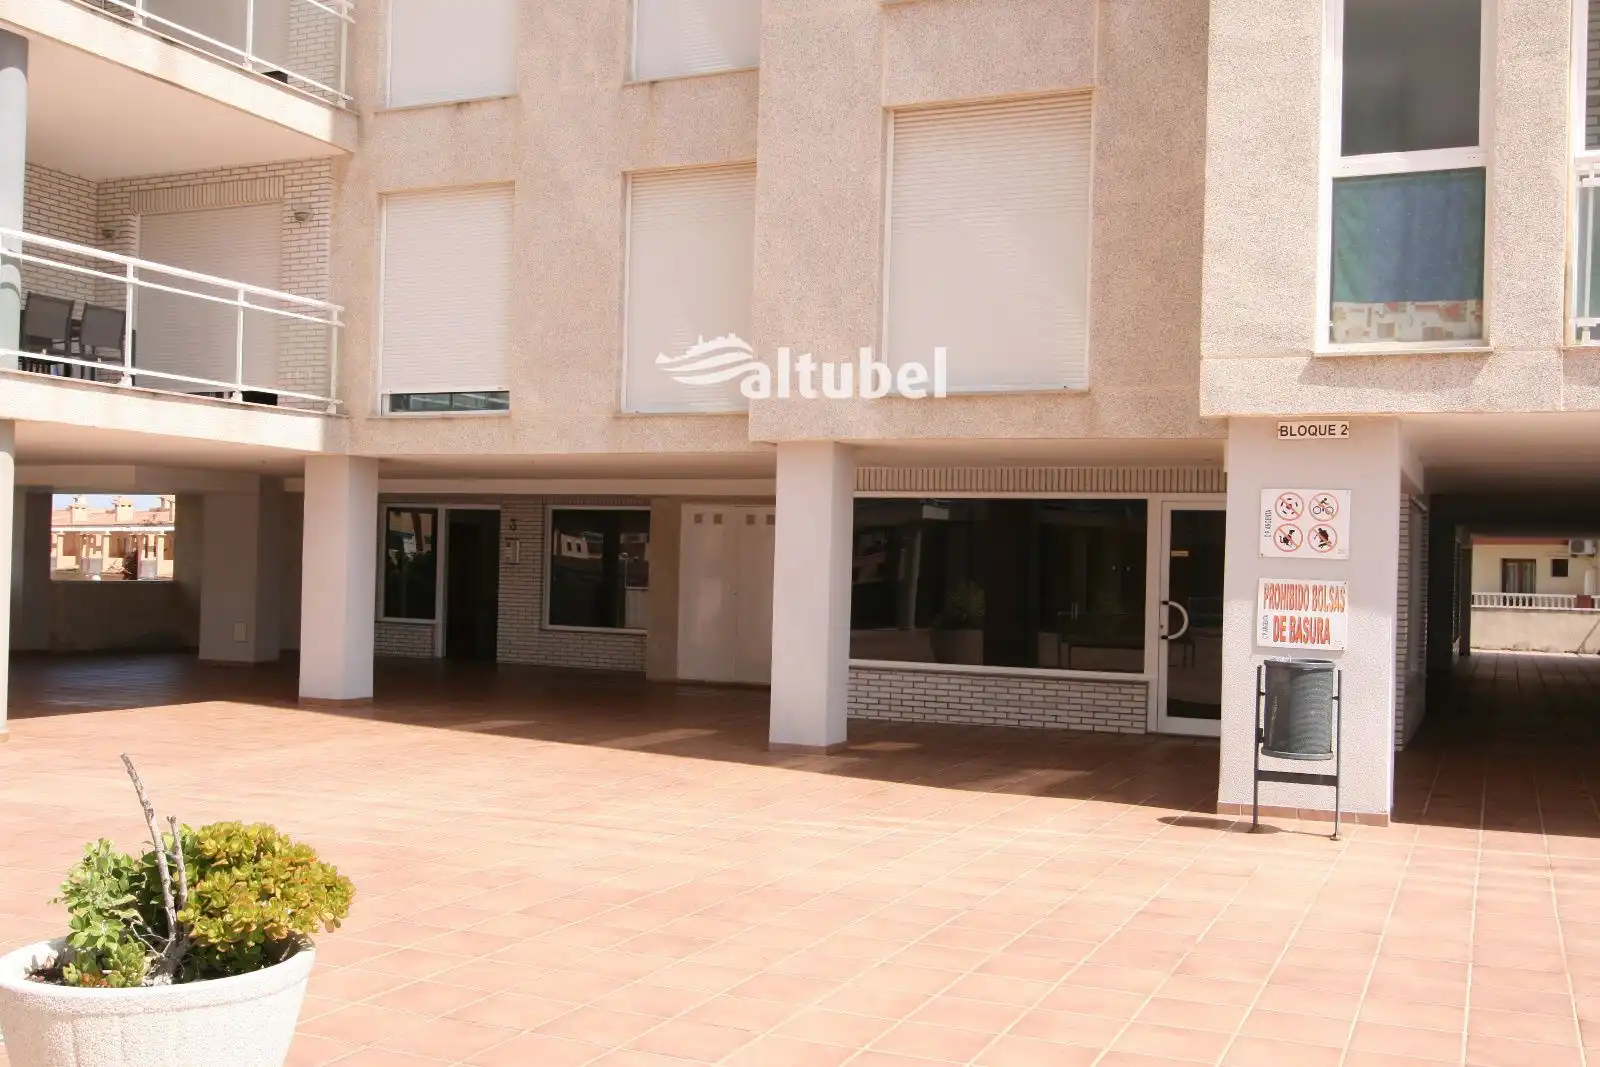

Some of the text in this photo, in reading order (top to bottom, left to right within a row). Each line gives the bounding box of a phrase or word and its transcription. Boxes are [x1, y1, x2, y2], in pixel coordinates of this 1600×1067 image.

[1280, 424, 1348, 437] BLOQUE 2
[1263, 583, 1345, 612] PROHIBIDO BOLSAS
[1273, 615, 1287, 642] DE
[1289, 616, 1330, 644] BASURA
